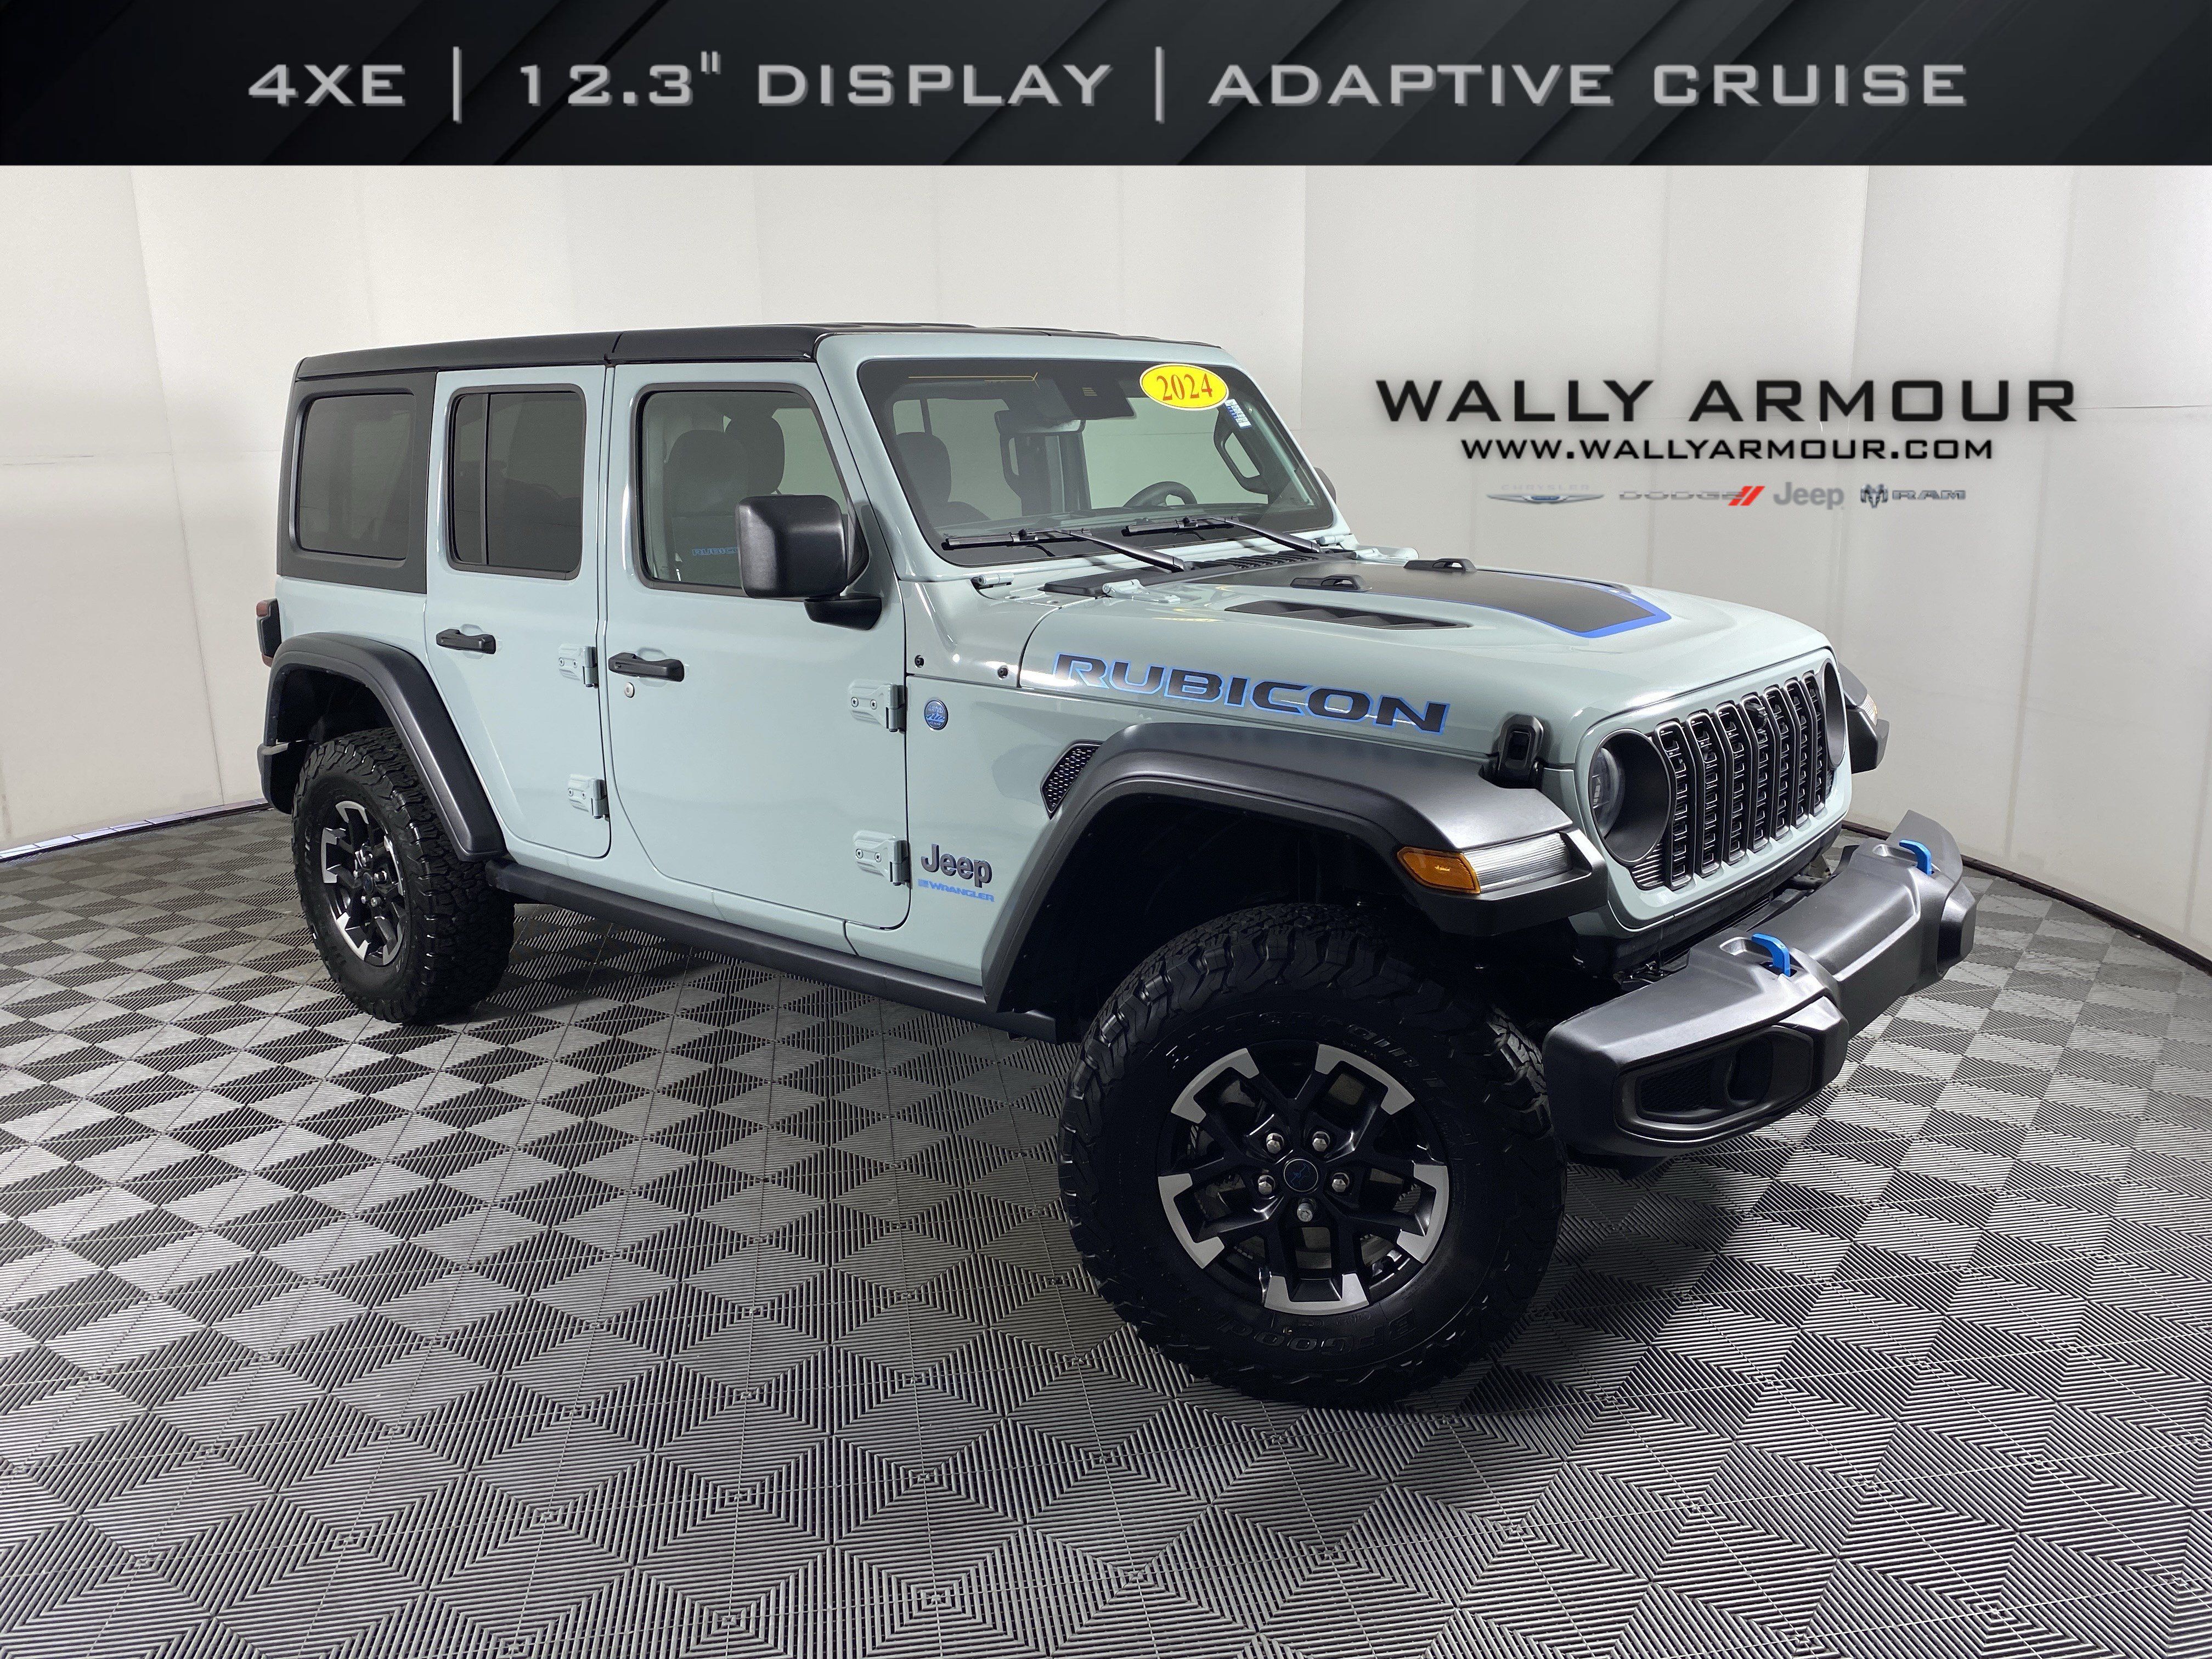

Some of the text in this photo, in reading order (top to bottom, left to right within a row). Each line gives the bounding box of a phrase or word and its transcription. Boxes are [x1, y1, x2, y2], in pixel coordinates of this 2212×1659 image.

[1156, 374, 1212, 400] 2024
[692, 546, 738, 556] RUBIC
[1052, 652, 1451, 736] RUBICON
[921, 843, 992, 888] Jeep
